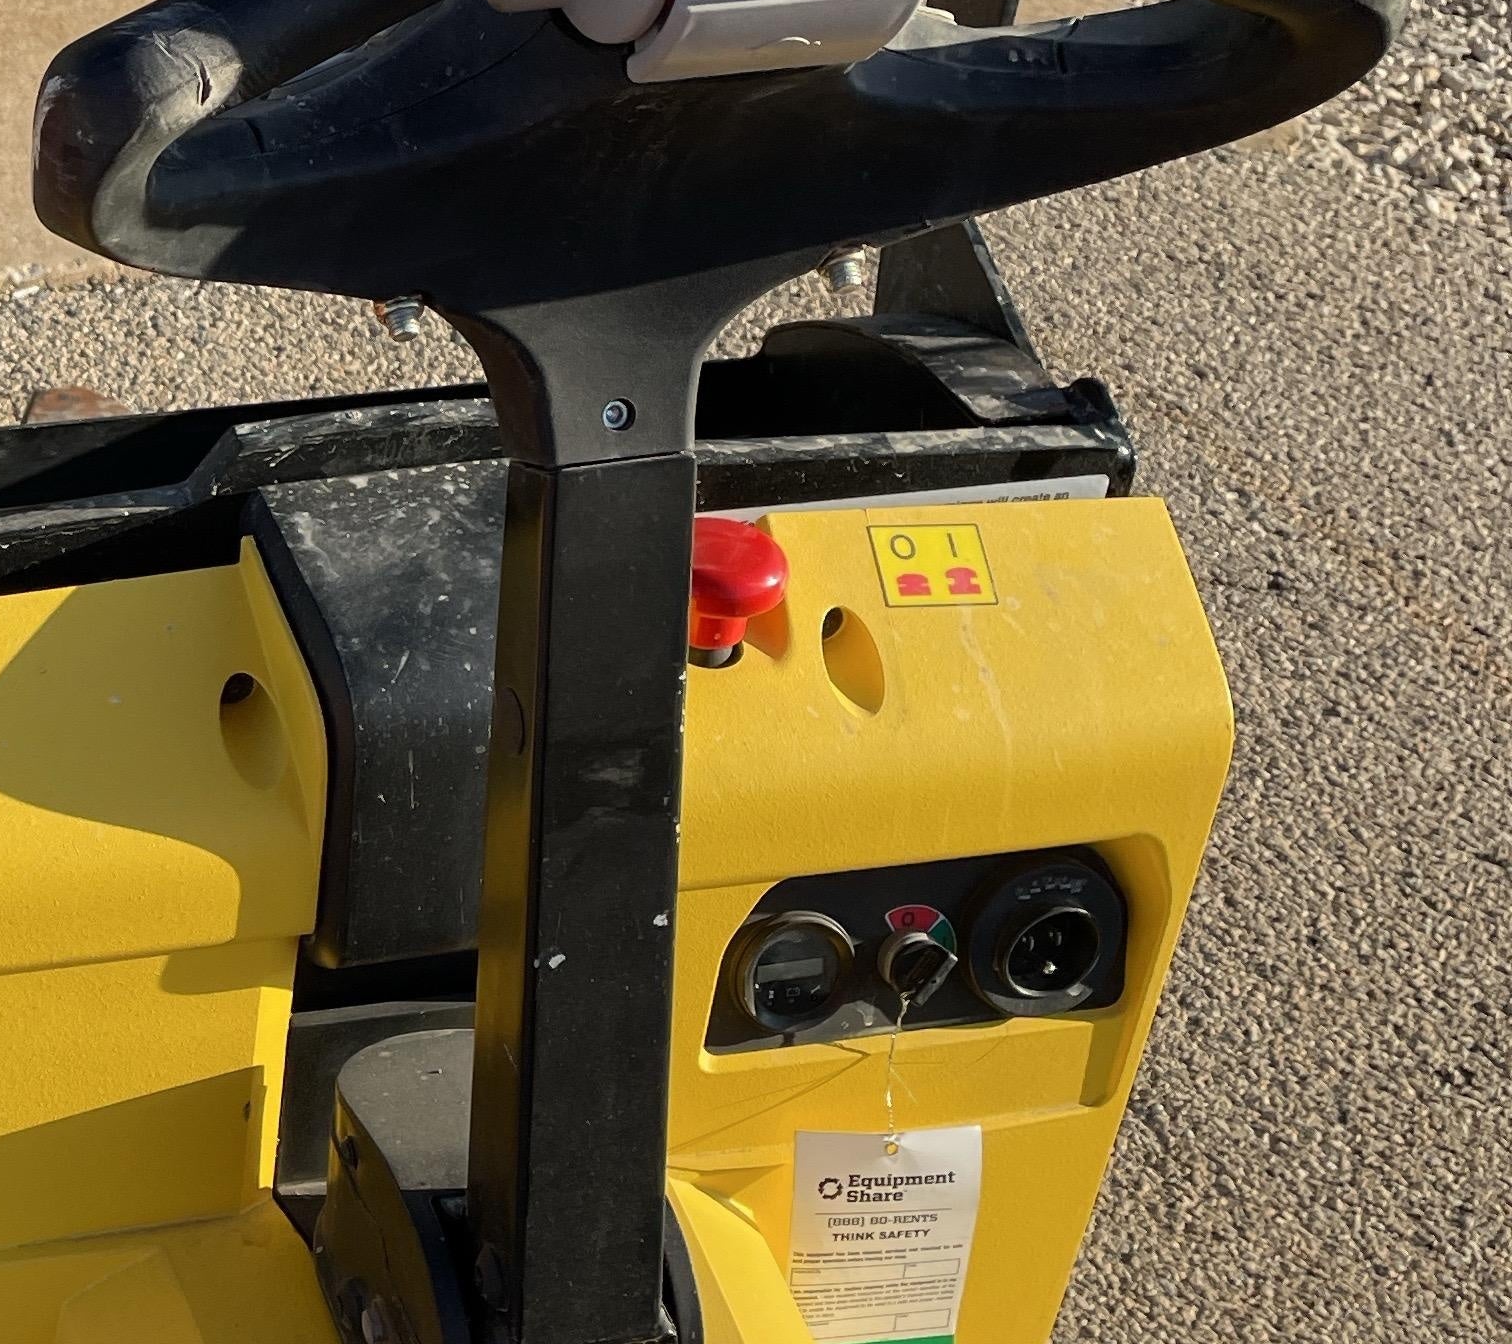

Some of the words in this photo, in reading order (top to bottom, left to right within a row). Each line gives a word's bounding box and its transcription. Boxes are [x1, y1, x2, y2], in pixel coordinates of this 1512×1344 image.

[847, 1171, 956, 1189] Equipment
[846, 1190, 904, 1203] Share
[832, 1231, 875, 1242] THINK
[879, 1229, 932, 1240] SAFETY
